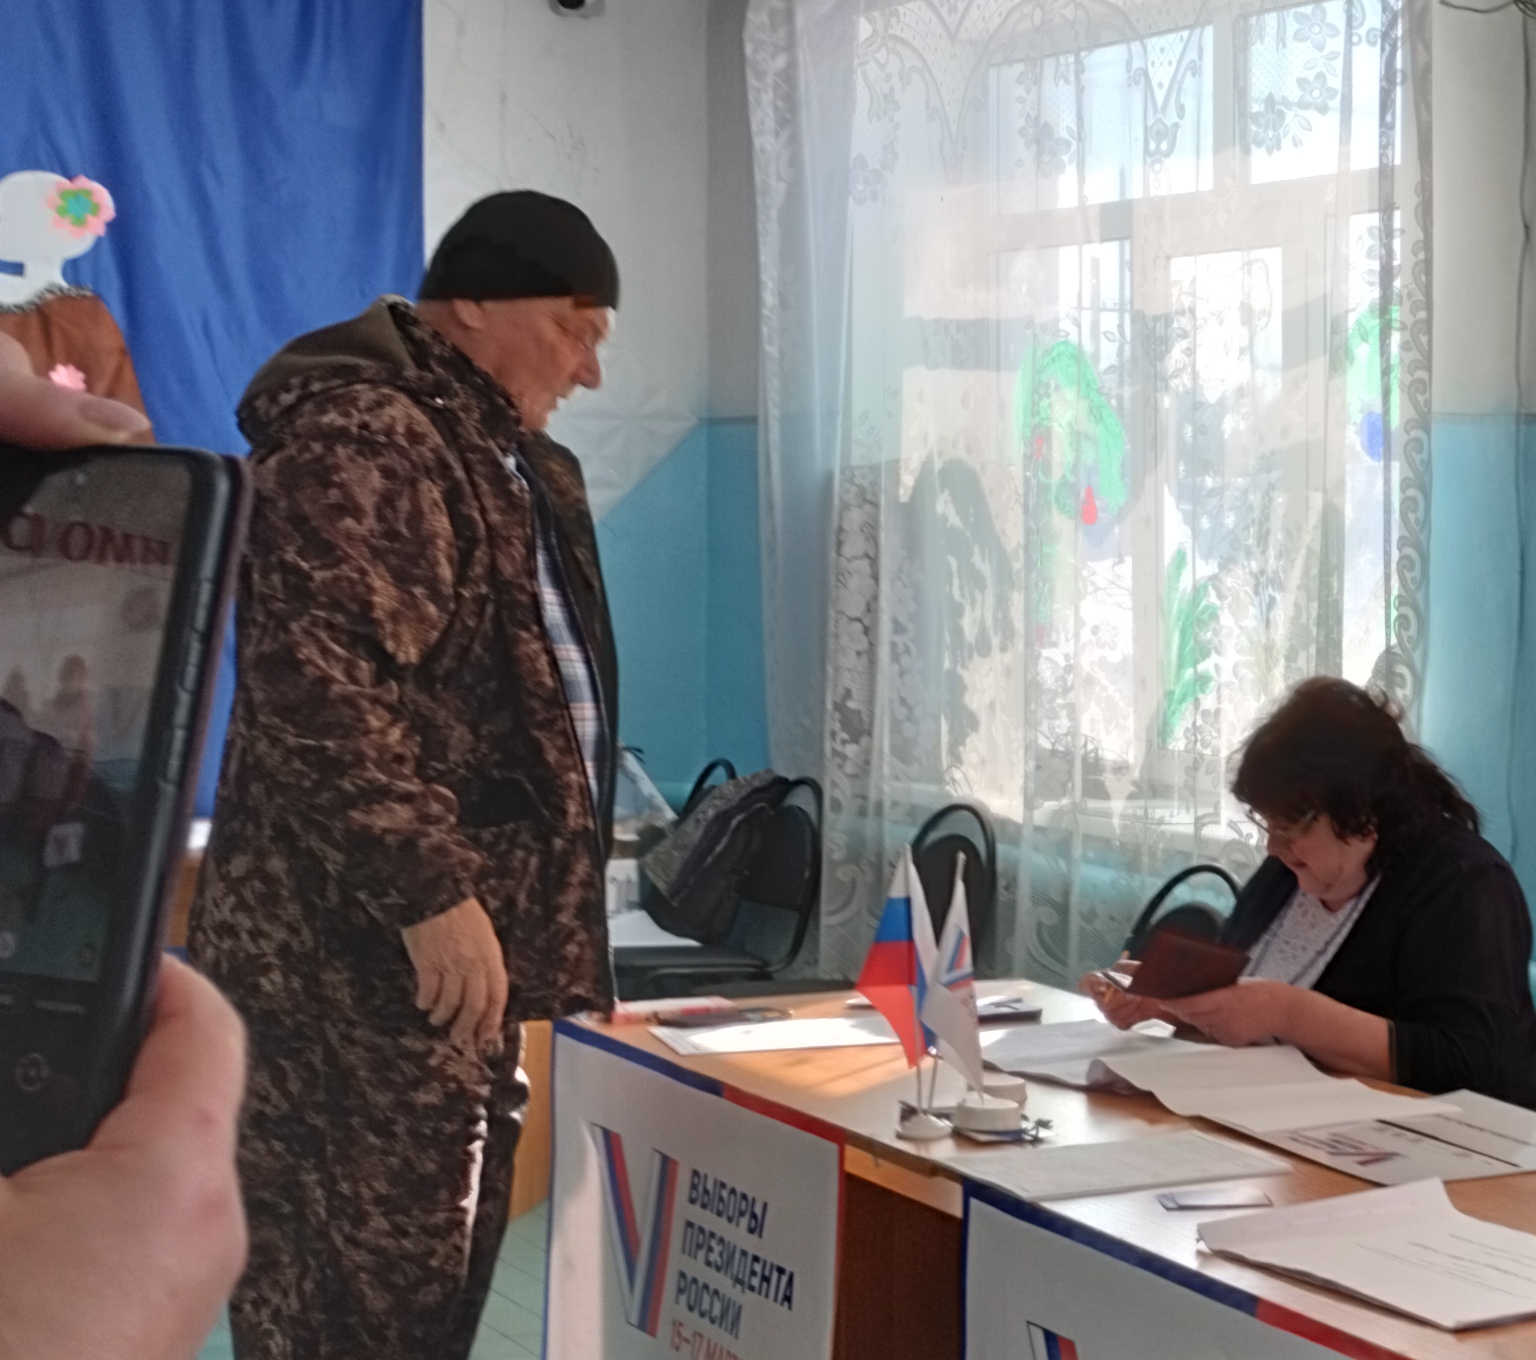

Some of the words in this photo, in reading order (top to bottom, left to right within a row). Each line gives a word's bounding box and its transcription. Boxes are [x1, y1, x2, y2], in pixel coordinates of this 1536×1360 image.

[687, 1167, 768, 1240] ВЫБОРЫ
[681, 1217, 795, 1312] ПРЕЗИДЕНТА
[674, 1268, 743, 1341] РОССИИ
